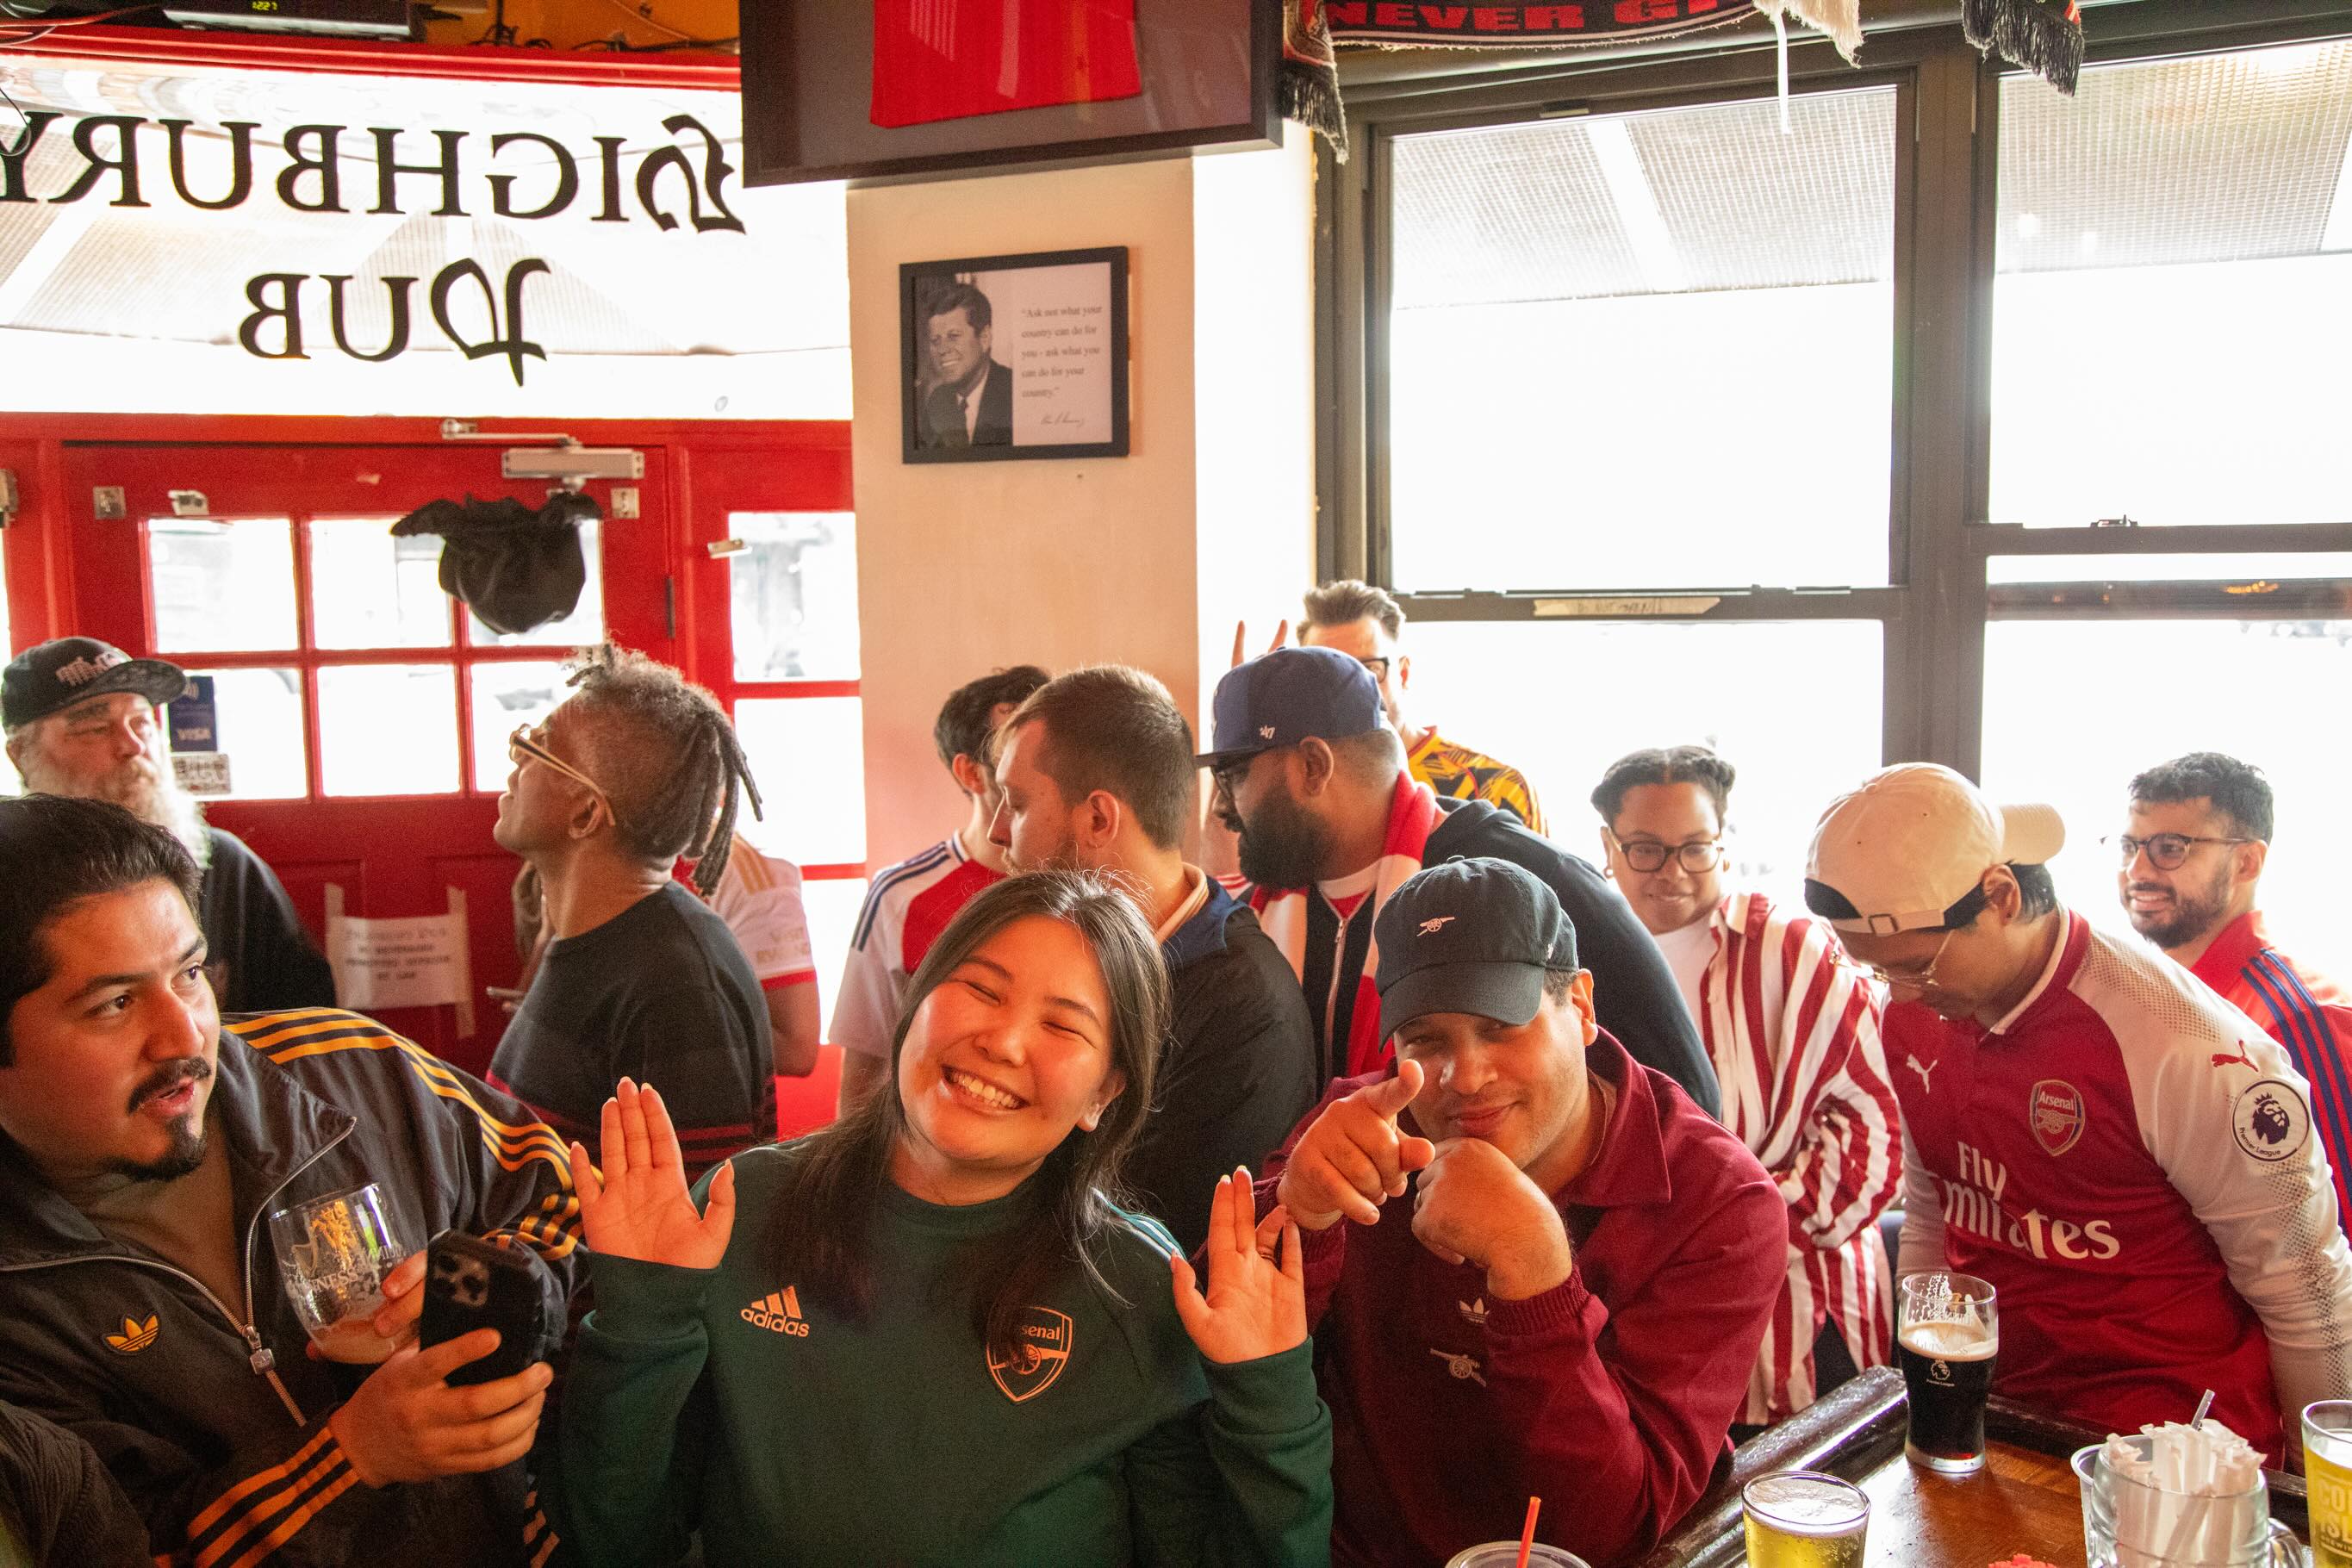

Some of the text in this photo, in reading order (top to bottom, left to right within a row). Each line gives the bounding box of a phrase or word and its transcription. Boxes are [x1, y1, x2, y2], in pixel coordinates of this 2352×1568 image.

[1324, 3, 1584, 30] NEVER
[2038, 1091, 2075, 1111] Arsenal
[2239, 1127, 2281, 1158] Premier League
[1957, 1140, 2007, 1202] Fly
[1943, 1178, 2120, 1260] mirates
[740, 1308, 810, 1337] adidas
[1020, 1325, 1061, 1341] senal
